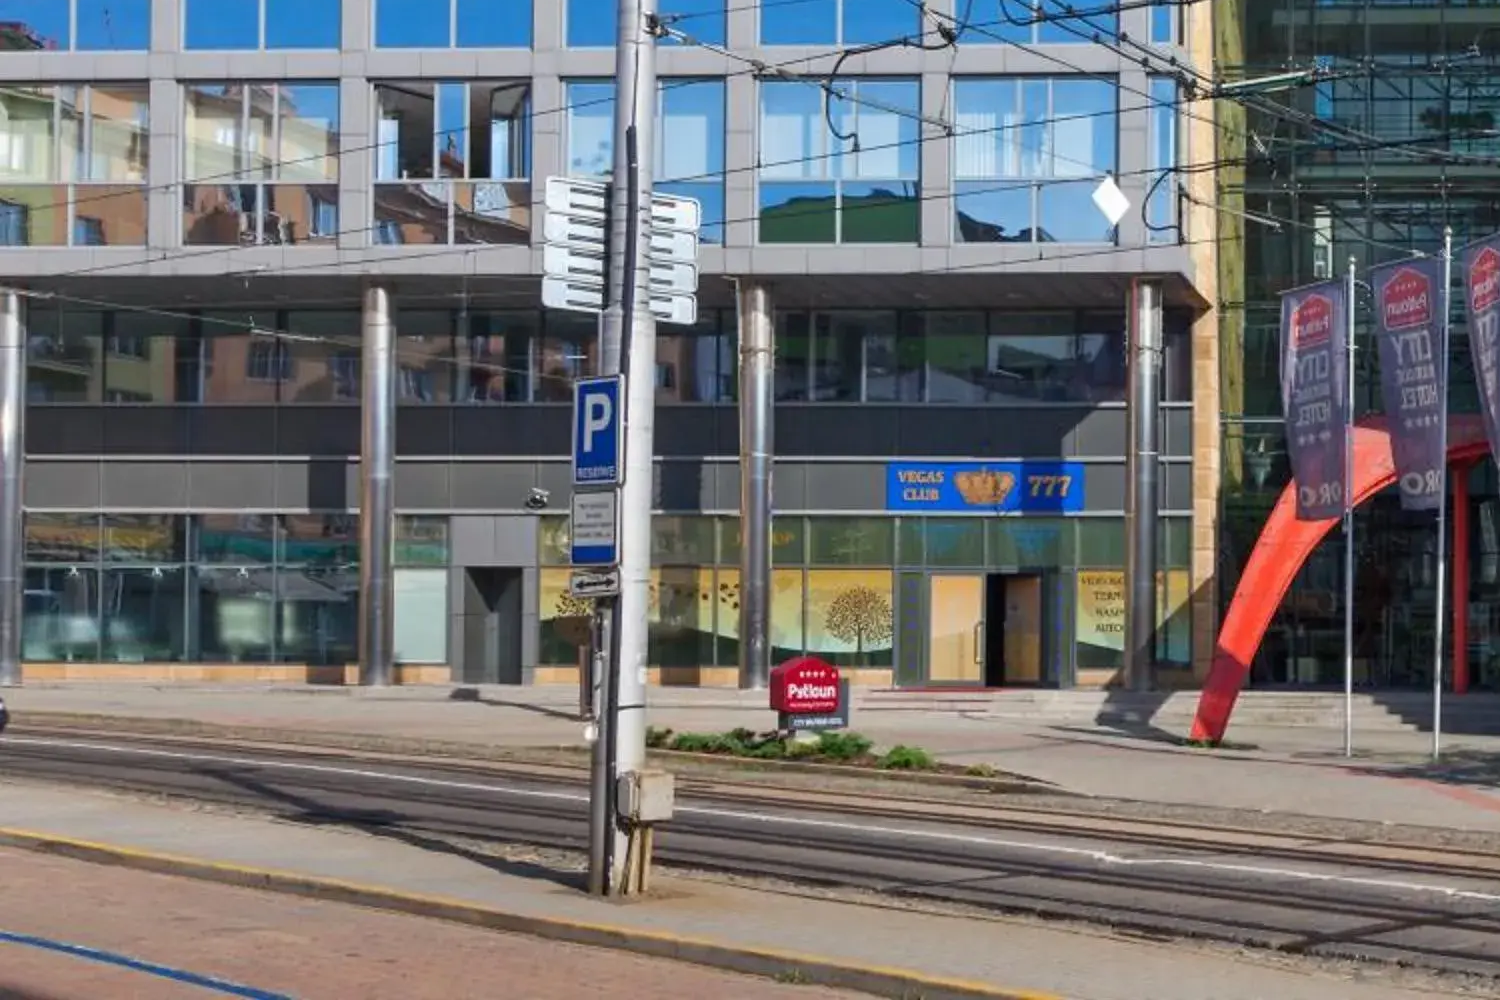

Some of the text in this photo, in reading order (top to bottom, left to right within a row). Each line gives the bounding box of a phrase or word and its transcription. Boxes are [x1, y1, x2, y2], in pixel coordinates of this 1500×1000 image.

[583, 394, 612, 453] P
[898, 469, 944, 484] VEGAS
[904, 487, 940, 501] CLUB
[1028, 475, 1072, 497] 777
[787, 683, 837, 699] Pytloun
